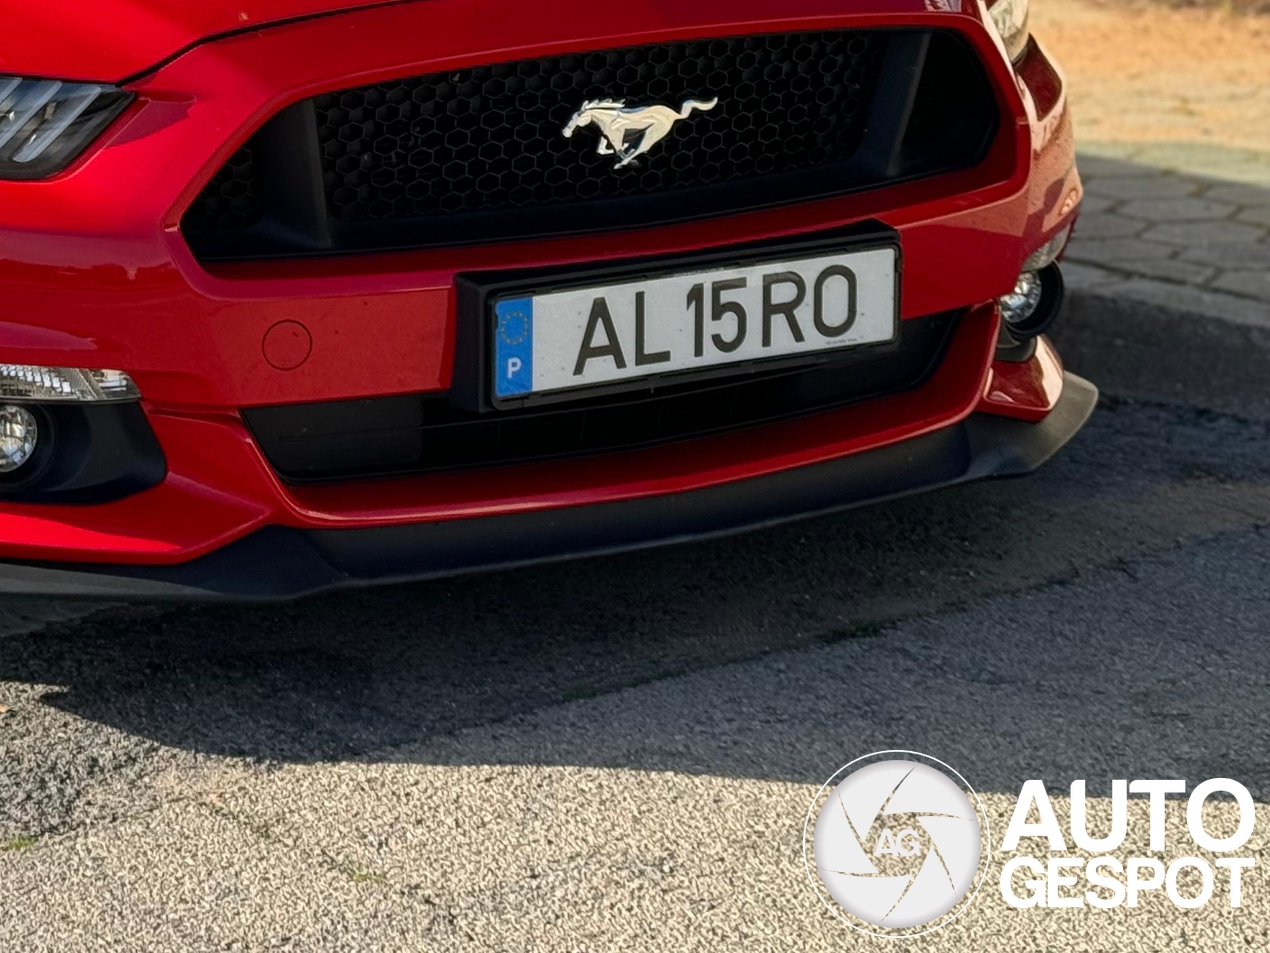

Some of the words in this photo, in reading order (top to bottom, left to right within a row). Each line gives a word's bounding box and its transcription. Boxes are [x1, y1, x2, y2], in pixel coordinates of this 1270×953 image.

[572, 291, 672, 377] AL
[686, 276, 747, 358] 15
[761, 264, 858, 348] RO
[506, 356, 523, 379] P
